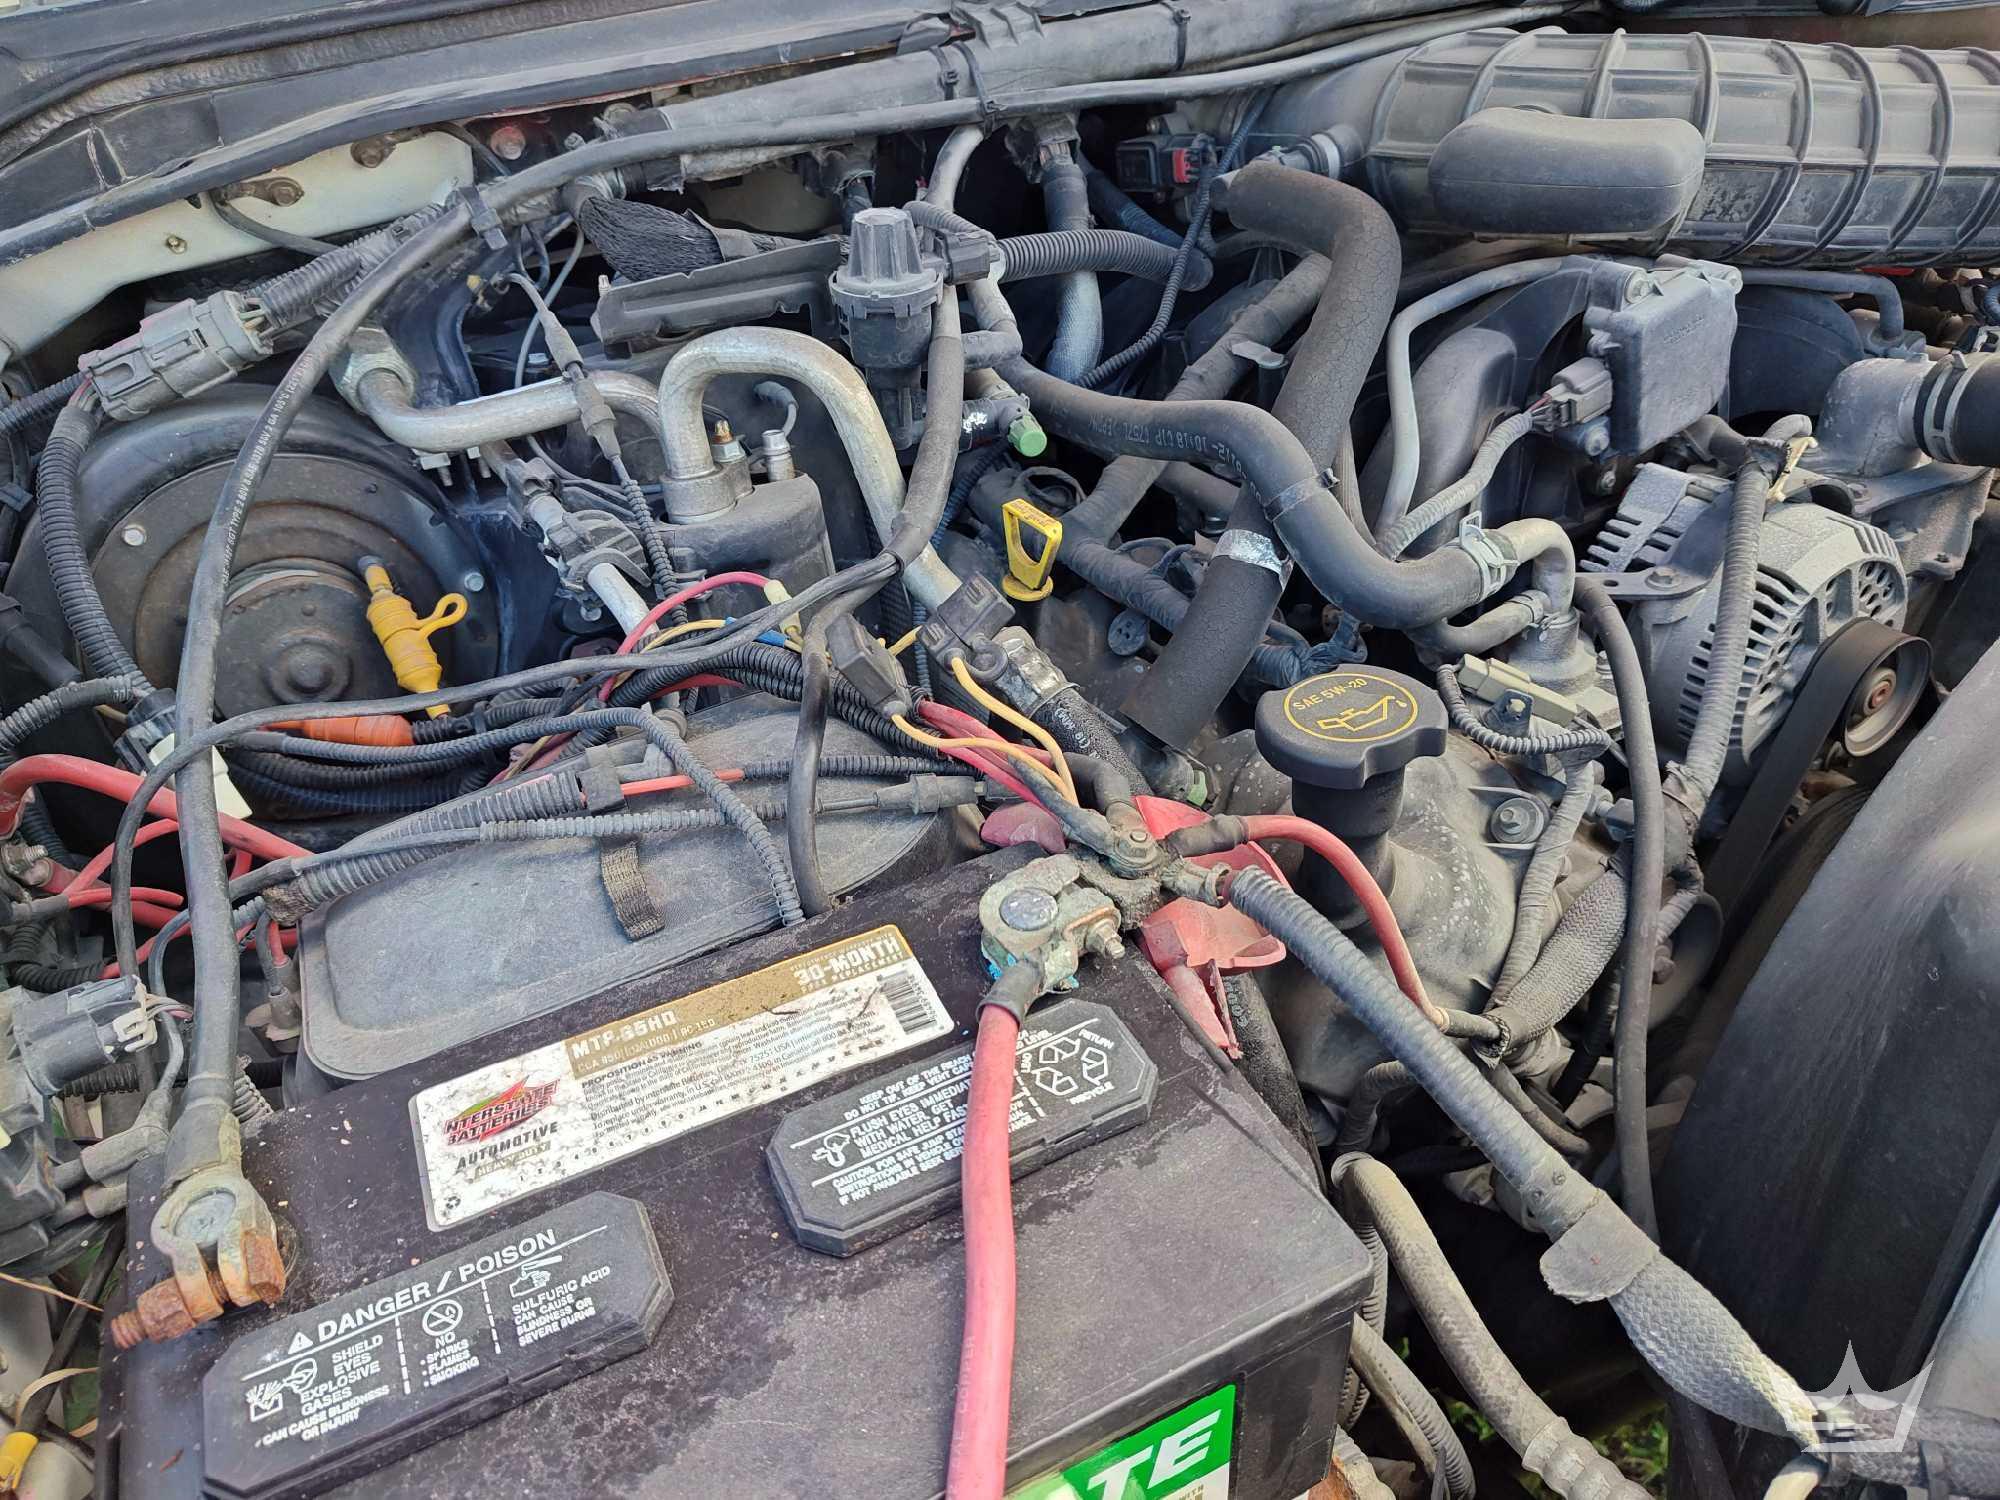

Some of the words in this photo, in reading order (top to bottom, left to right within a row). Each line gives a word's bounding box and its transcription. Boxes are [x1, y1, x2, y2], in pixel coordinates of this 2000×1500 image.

[231, 508, 244, 529] TYPE
[1292, 694, 1324, 711] SAE
[1321, 678, 1369, 699] 5W-20
[794, 936, 901, 986] 30-MONTH
[831, 951, 904, 981] REPLACEMENT
[571, 1010, 678, 1059] MTP-65HD
[1078, 1028, 1116, 1050] RETURN
[582, 1059, 647, 1088] PROPOSITION
[860, 1090, 885, 1105] KEEP
[885, 1083, 907, 1096] OUT
[907, 1074, 920, 1087] OF
[921, 1065, 941, 1080] THE
[940, 1054, 972, 1073] REACH
[844, 1109, 860, 1121] DO
[861, 1100, 881, 1115] NOT
[903, 1082, 927, 1098] KEEP
[926, 1073, 951, 1088] VENT
[850, 1114, 890, 1140] FLUSH
[889, 1102, 920, 1123] EYES
[921, 1078, 973, 1109] IMMEDIAT
[1069, 1080, 1116, 1106] RECYCLE
[853, 1129, 887, 1150] WITH
[887, 1112, 931, 1135] WATER.
[931, 1099, 955, 1116] GET
[860, 1133, 912, 1159] MEDICAL
[913, 1119, 943, 1138] HELP
[456, 1121, 559, 1174] AUTOMOTIVE
[876, 1154, 896, 1171] FOR
[896, 1145, 922, 1163] SAFE
[921, 1134, 945, 1154] JUMP
[837, 1162, 904, 1196] INSTRUCTIONS
[903, 1154, 916, 1168] IN
[915, 1141, 953, 1166] VEHICLE
[838, 1193, 850, 1207] IF
[851, 1185, 872, 1203] NOT
[872, 1166, 921, 1193] AVAILABLE
[920, 1155, 945, 1173] SEEK
[317, 1281, 431, 1343] DANGER
[436, 1270, 453, 1294] /
[458, 1228, 557, 1283] POISON
[511, 1279, 579, 1316] SULFURIC
[580, 1265, 611, 1289] ACID
[514, 1310, 537, 1326] CAN
[540, 1293, 575, 1315] CAUSE
[516, 1307, 573, 1337] BLINDNESS
[575, 1296, 594, 1311] OR
[518, 1322, 561, 1347] SEVERE
[560, 1306, 597, 1328] BURNS
[331, 1334, 384, 1364] SHIELD
[426, 1339, 470, 1364] SPARKS
[434, 1331, 456, 1349] NO
[333, 1352, 373, 1378] EYES
[428, 1349, 471, 1375] FLAMES
[430, 1356, 480, 1387] SMOKING
[300, 1360, 382, 1404] EXPLOSIVE
[261, 1426, 289, 1447] CAN
[287, 1411, 328, 1436] CAUSE
[328, 1384, 391, 1419] BLINDNESS
[301, 1386, 353, 1417] GASES
[301, 1428, 320, 1442] OR
[320, 1407, 361, 1433] INJURY
